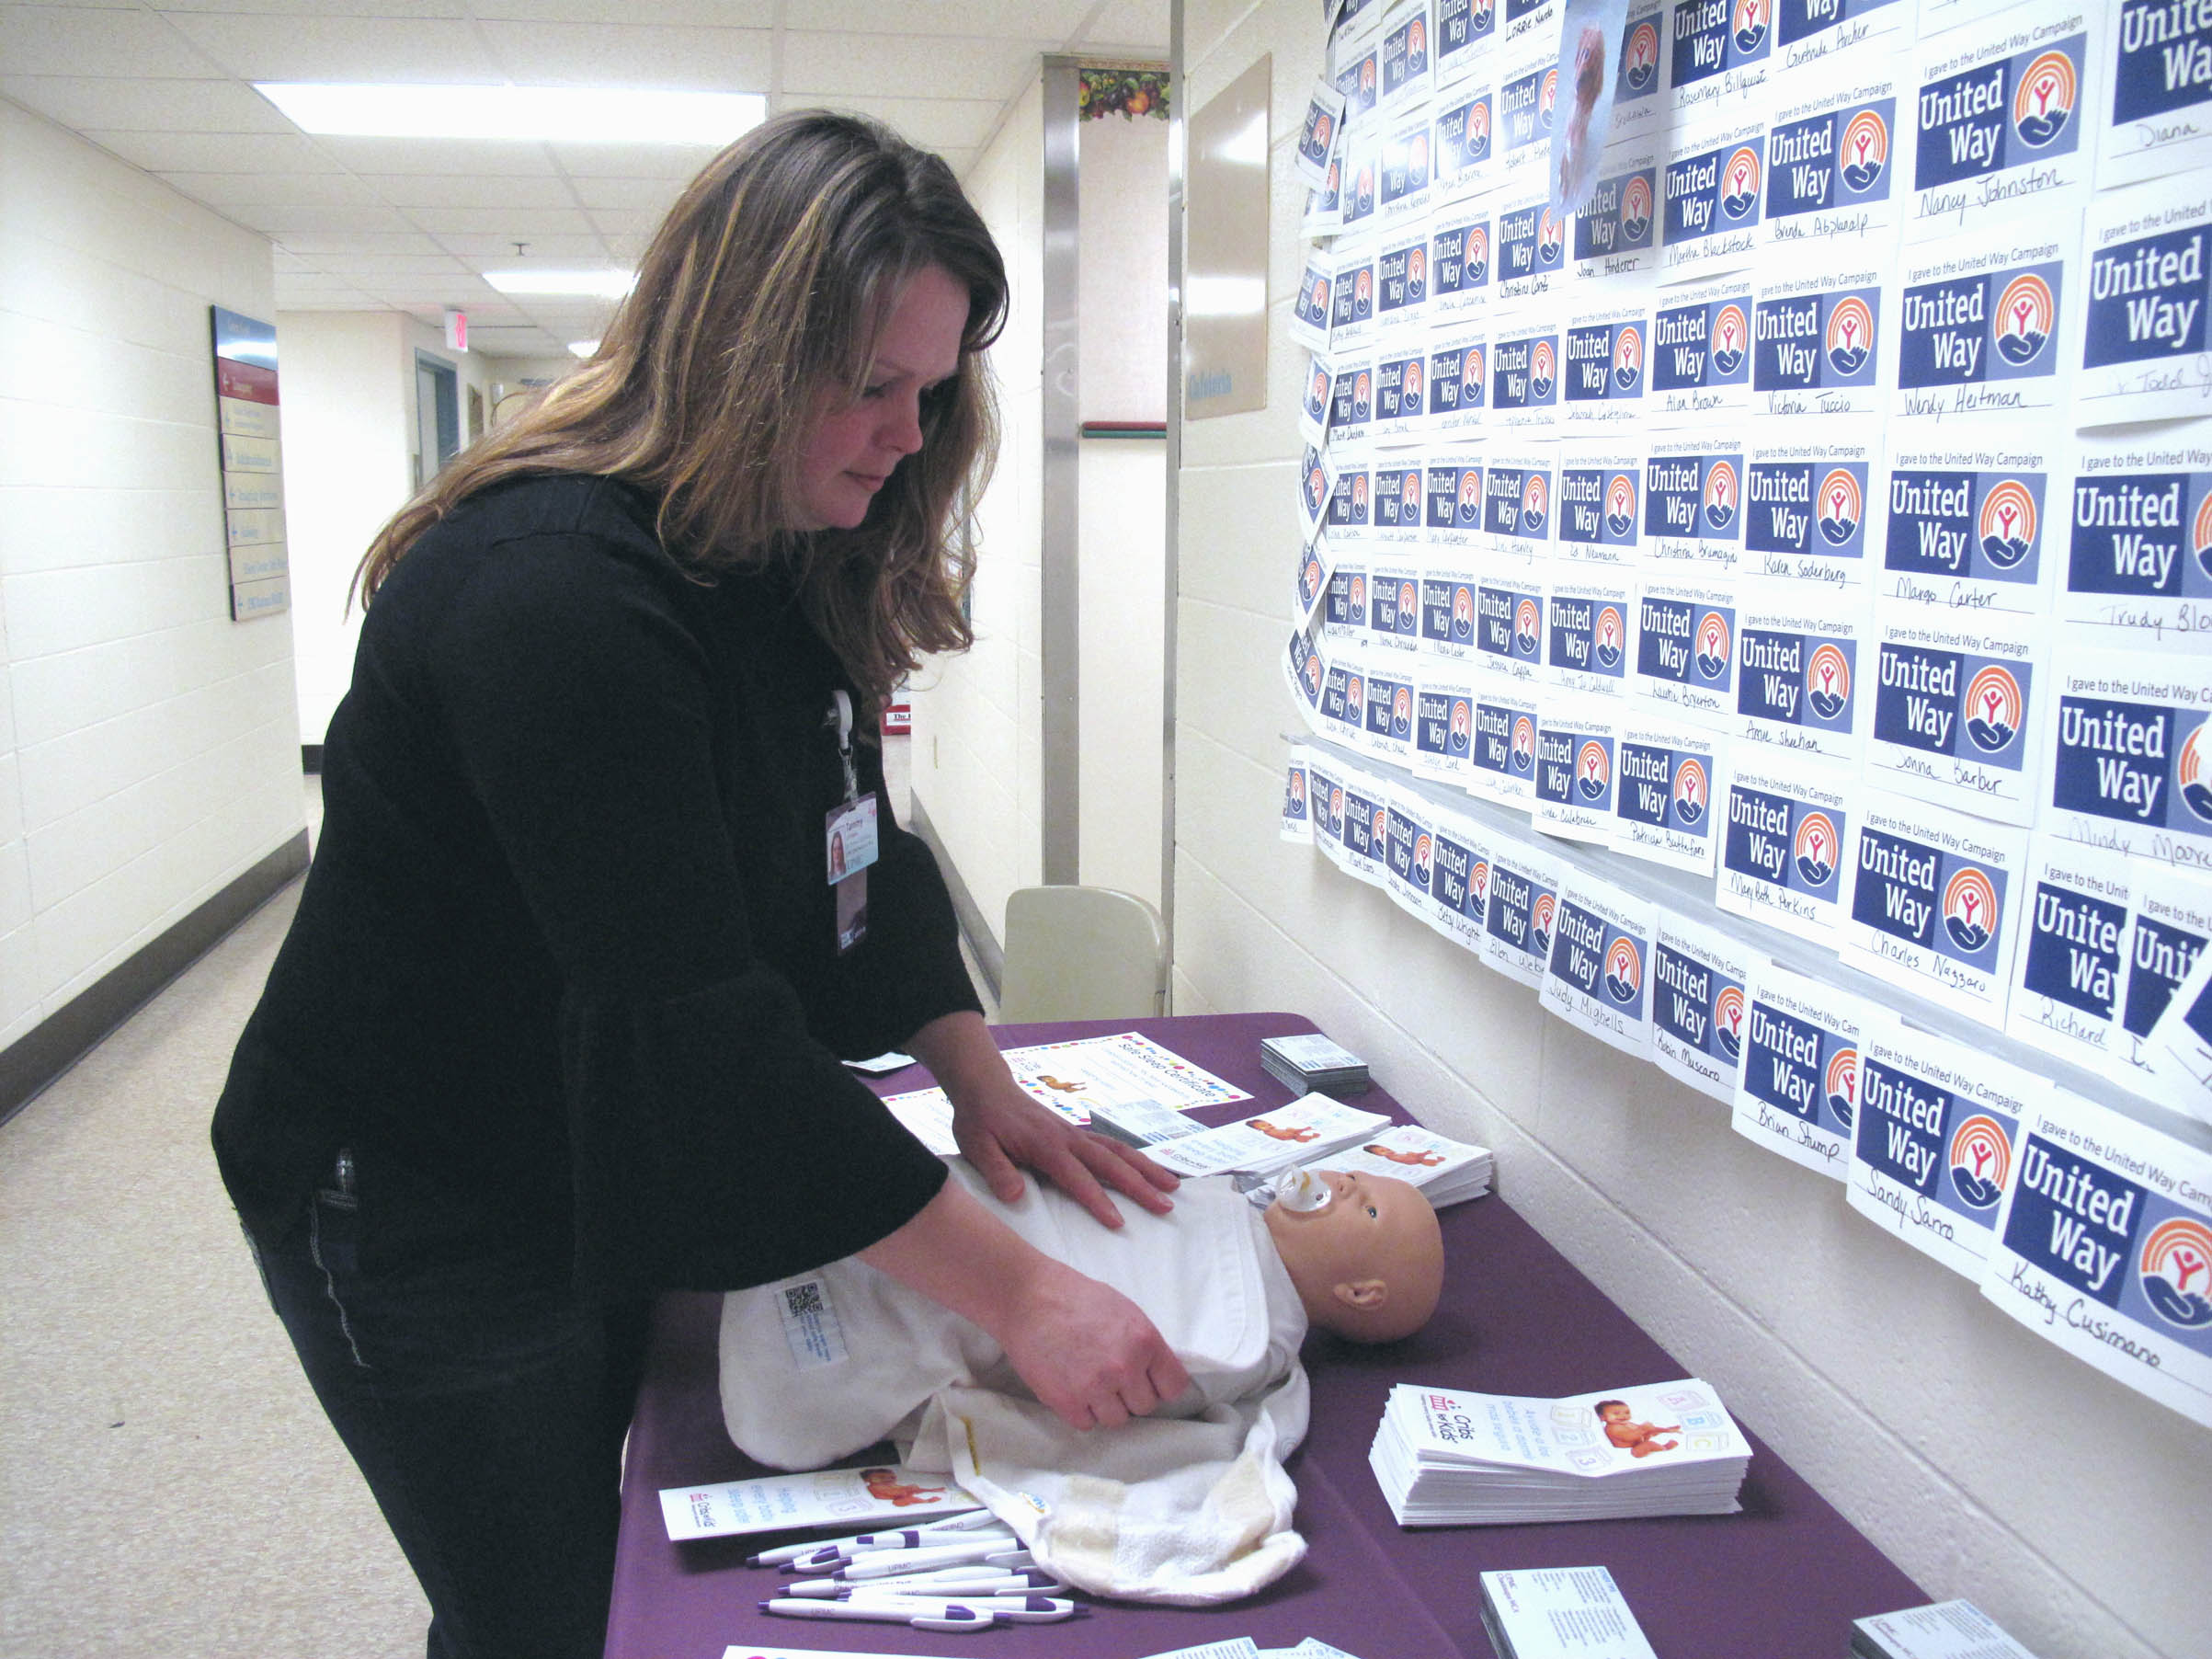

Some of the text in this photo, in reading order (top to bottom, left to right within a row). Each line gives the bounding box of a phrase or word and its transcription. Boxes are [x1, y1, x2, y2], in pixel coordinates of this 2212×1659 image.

[1675, 0, 1727, 40] United
[2123, 0, 2212, 52] Unite
[1693, 33, 1726, 70] Way
[1930, 60, 1947, 79] gave
[1949, 57, 1957, 71] to
[1960, 51, 1974, 67] the
[1977, 40, 2007, 61] United
[2009, 32, 2029, 52] Way
[2032, 14, 2083, 49] Campaign
[2163, 35, 2212, 91] Wa
[1921, 69, 2003, 131] United
[1772, 120, 1831, 166] United
[1949, 122, 2001, 167] Way
[2137, 122, 2199, 147] Diana
[1666, 157, 1716, 200] United
[1792, 166, 1830, 204] Way
[1920, 167, 2064, 226] Nancy Johnston
[1500, 212, 1534, 244] United
[1591, 218, 1615, 250] Way
[1682, 199, 1714, 232] Way
[1512, 245, 1534, 271] Way
[1577, 262, 1594, 277] Joan
[2092, 235, 2202, 302] United
[1757, 303, 1818, 341] United
[1905, 283, 1983, 332] United
[2126, 297, 2200, 349] Way
[1657, 311, 1706, 346] United
[1674, 348, 1705, 383] Way
[1777, 343, 1817, 383] Way
[1933, 332, 1981, 377] Way
[1815, 391, 1851, 413] Tuccio
[1906, 387, 1944, 423] Wendy
[1648, 463, 1699, 493] United
[1900, 454, 1917, 467] gave
[1919, 454, 1927, 465] to
[1930, 453, 1943, 464] the
[1944, 453, 1973, 465] United
[1975, 453, 1994, 468] Way
[1996, 453, 2043, 469] Campaign
[1488, 475, 1520, 498] United
[1563, 475, 1601, 502] United
[1750, 471, 1809, 502] United
[1892, 480, 1969, 518] United
[2077, 483, 2180, 528] United
[1499, 501, 1518, 532] Way
[1575, 505, 1599, 539] Way
[1666, 497, 1697, 532] Way
[1772, 506, 1808, 548] Way
[1763, 553, 1792, 577] Karen
[1918, 521, 1967, 570] Way
[2113, 534, 2177, 589] Way
[1897, 578, 1998, 609] Margo Carter
[1552, 603, 1591, 631] United
[1642, 605, 1691, 637] United
[2100, 605, 2162, 641] Trudy
[1566, 633, 1589, 667] Way
[1659, 638, 1688, 677] Way
[1742, 636, 1800, 673] United
[1881, 651, 1955, 698] United
[2072, 679, 2095, 693] gave
[2098, 680, 2108, 692] to
[2111, 679, 2128, 695] the
[2132, 681, 2169, 698] United
[2172, 684, 2199, 704] Way
[1419, 697, 1448, 721] United
[1764, 674, 1798, 718] Way
[1429, 722, 1446, 749] Way
[1906, 696, 1953, 748] Way
[2062, 707, 2164, 758] United
[1538, 737, 1571, 764] United
[1622, 750, 1669, 783] United
[1891, 746, 2003, 795] Donna Barber
[1548, 765, 1570, 799] Way
[1638, 783, 1667, 821] Way
[2097, 757, 2161, 818] Way
[1730, 793, 1788, 837] United
[1435, 841, 1467, 877] United
[1749, 832, 1785, 879] Way
[1861, 836, 1935, 892] United
[1444, 872, 1465, 909] Way
[1492, 871, 1529, 911] United
[1503, 905, 1527, 944] Way
[1558, 906, 1604, 955] United
[1886, 883, 1931, 939] Way
[1569, 944, 1598, 990] Way
[1871, 930, 1920, 969] Charles
[1657, 950, 1708, 1004] United
[1673, 993, 1706, 1044] Way
[2041, 995, 2107, 1047] Richard
[1752, 1010, 1818, 1070] United
[1773, 1058, 1815, 1115] Way
[1864, 1068, 1944, 1138] United
[1758, 1101, 1839, 1162] Brian Stump
[1887, 1122, 1937, 1186] Way
[2043, 1120, 2067, 1141] gave
[2069, 1129, 2080, 1146] to
[2083, 1133, 2103, 1155] the
[2104, 1141, 2146, 1176] United
[2148, 1159, 2176, 1193] Way
[1866, 1168, 1908, 1229] Sandy
[2023, 1144, 2135, 1237] United
[2050, 1210, 2120, 1291] Way
[2011, 1261, 2161, 1368] Kathy Cusimano
